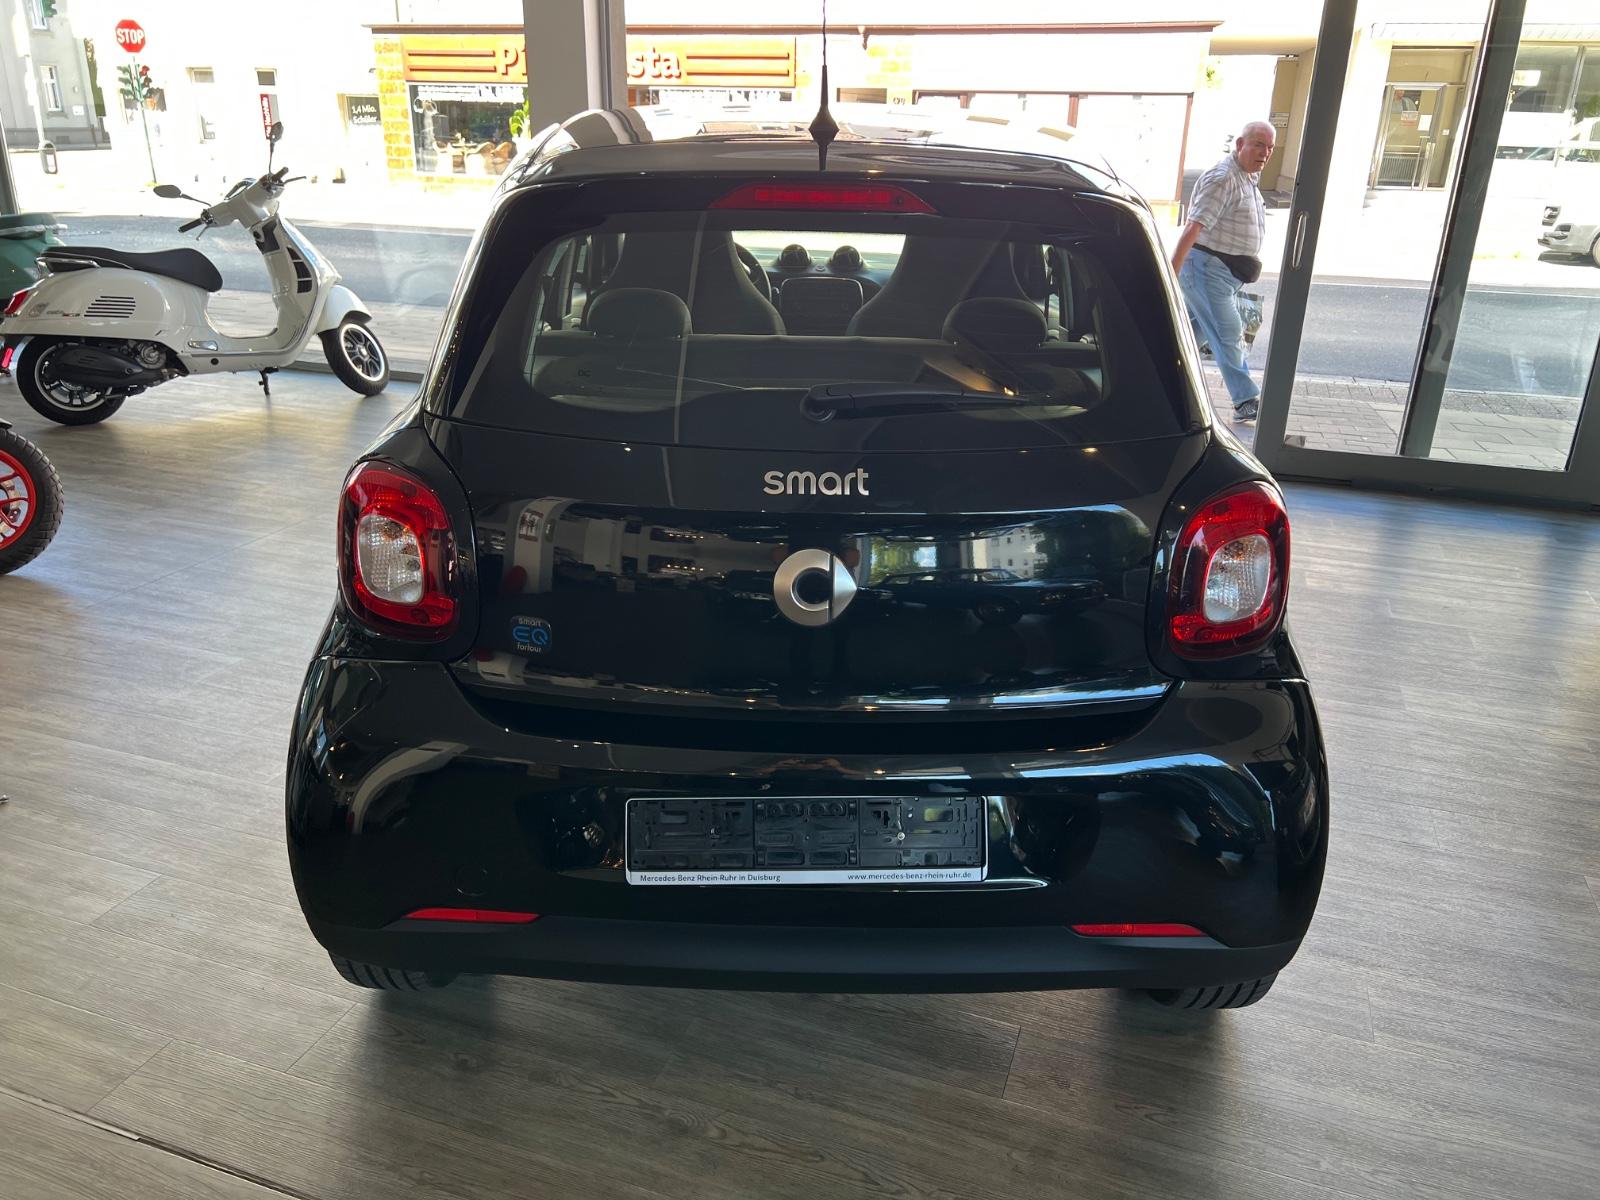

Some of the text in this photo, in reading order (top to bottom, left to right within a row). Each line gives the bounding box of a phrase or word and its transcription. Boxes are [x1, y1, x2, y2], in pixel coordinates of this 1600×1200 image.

[117, 28, 145, 45] STOP
[500, 44, 682, 78] Pi sta
[763, 468, 870, 496] smart
[512, 625, 549, 645] EQ
[747, 873, 781, 882] Duisburg
